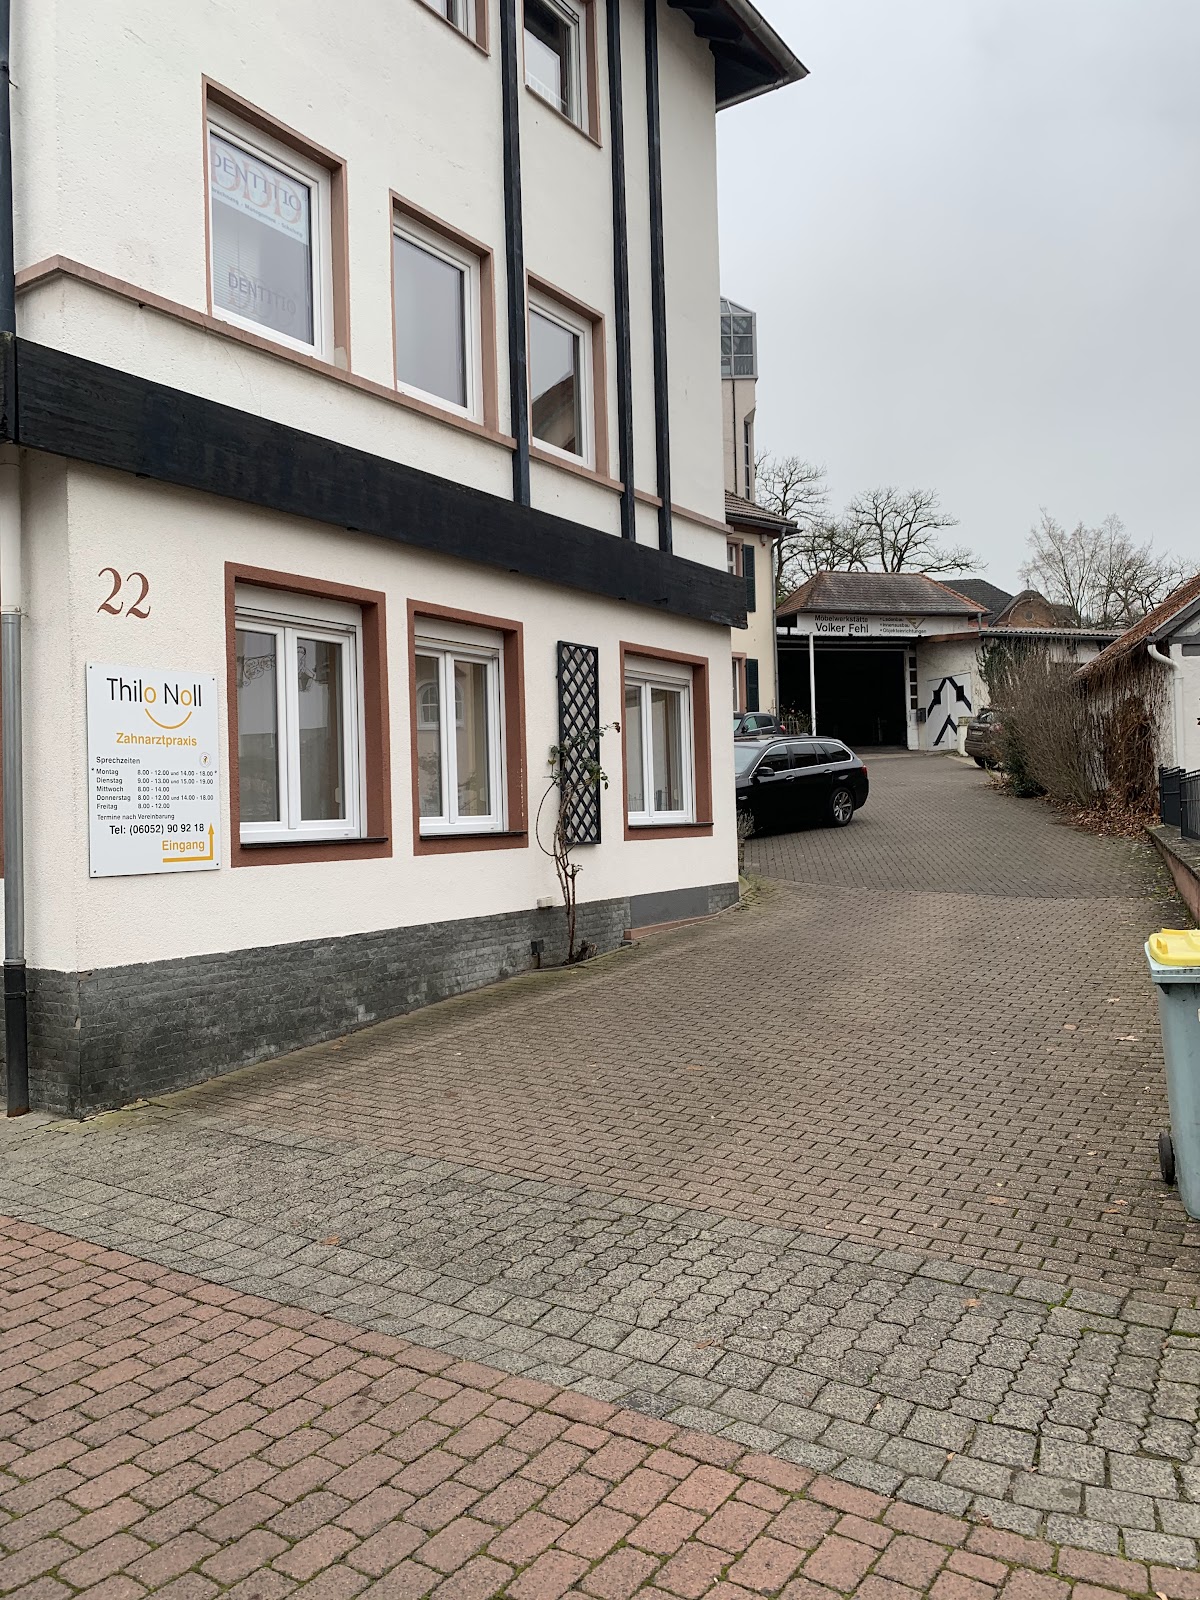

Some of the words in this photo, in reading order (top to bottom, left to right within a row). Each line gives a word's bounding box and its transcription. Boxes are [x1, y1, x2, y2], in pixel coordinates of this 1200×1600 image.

[97, 567, 151, 619] 22
[815, 622, 846, 633] Volker
[848, 623, 869, 633] Fehl
[106, 677, 157, 704] Thilo
[164, 682, 202, 707] Noll
[116, 732, 198, 748] Zahnarztpraxis
[96, 756, 141, 765] Sprechzeiten
[96, 768, 119, 776] Montag
[96, 794, 131, 802] Donnerstag
[109, 825, 126, 835] Tel:
[129, 824, 164, 836] (06052)
[167, 824, 178, 833] 90
[180, 823, 192, 833] 92
[194, 823, 205, 832] 18
[161, 840, 205, 852] Eingang
